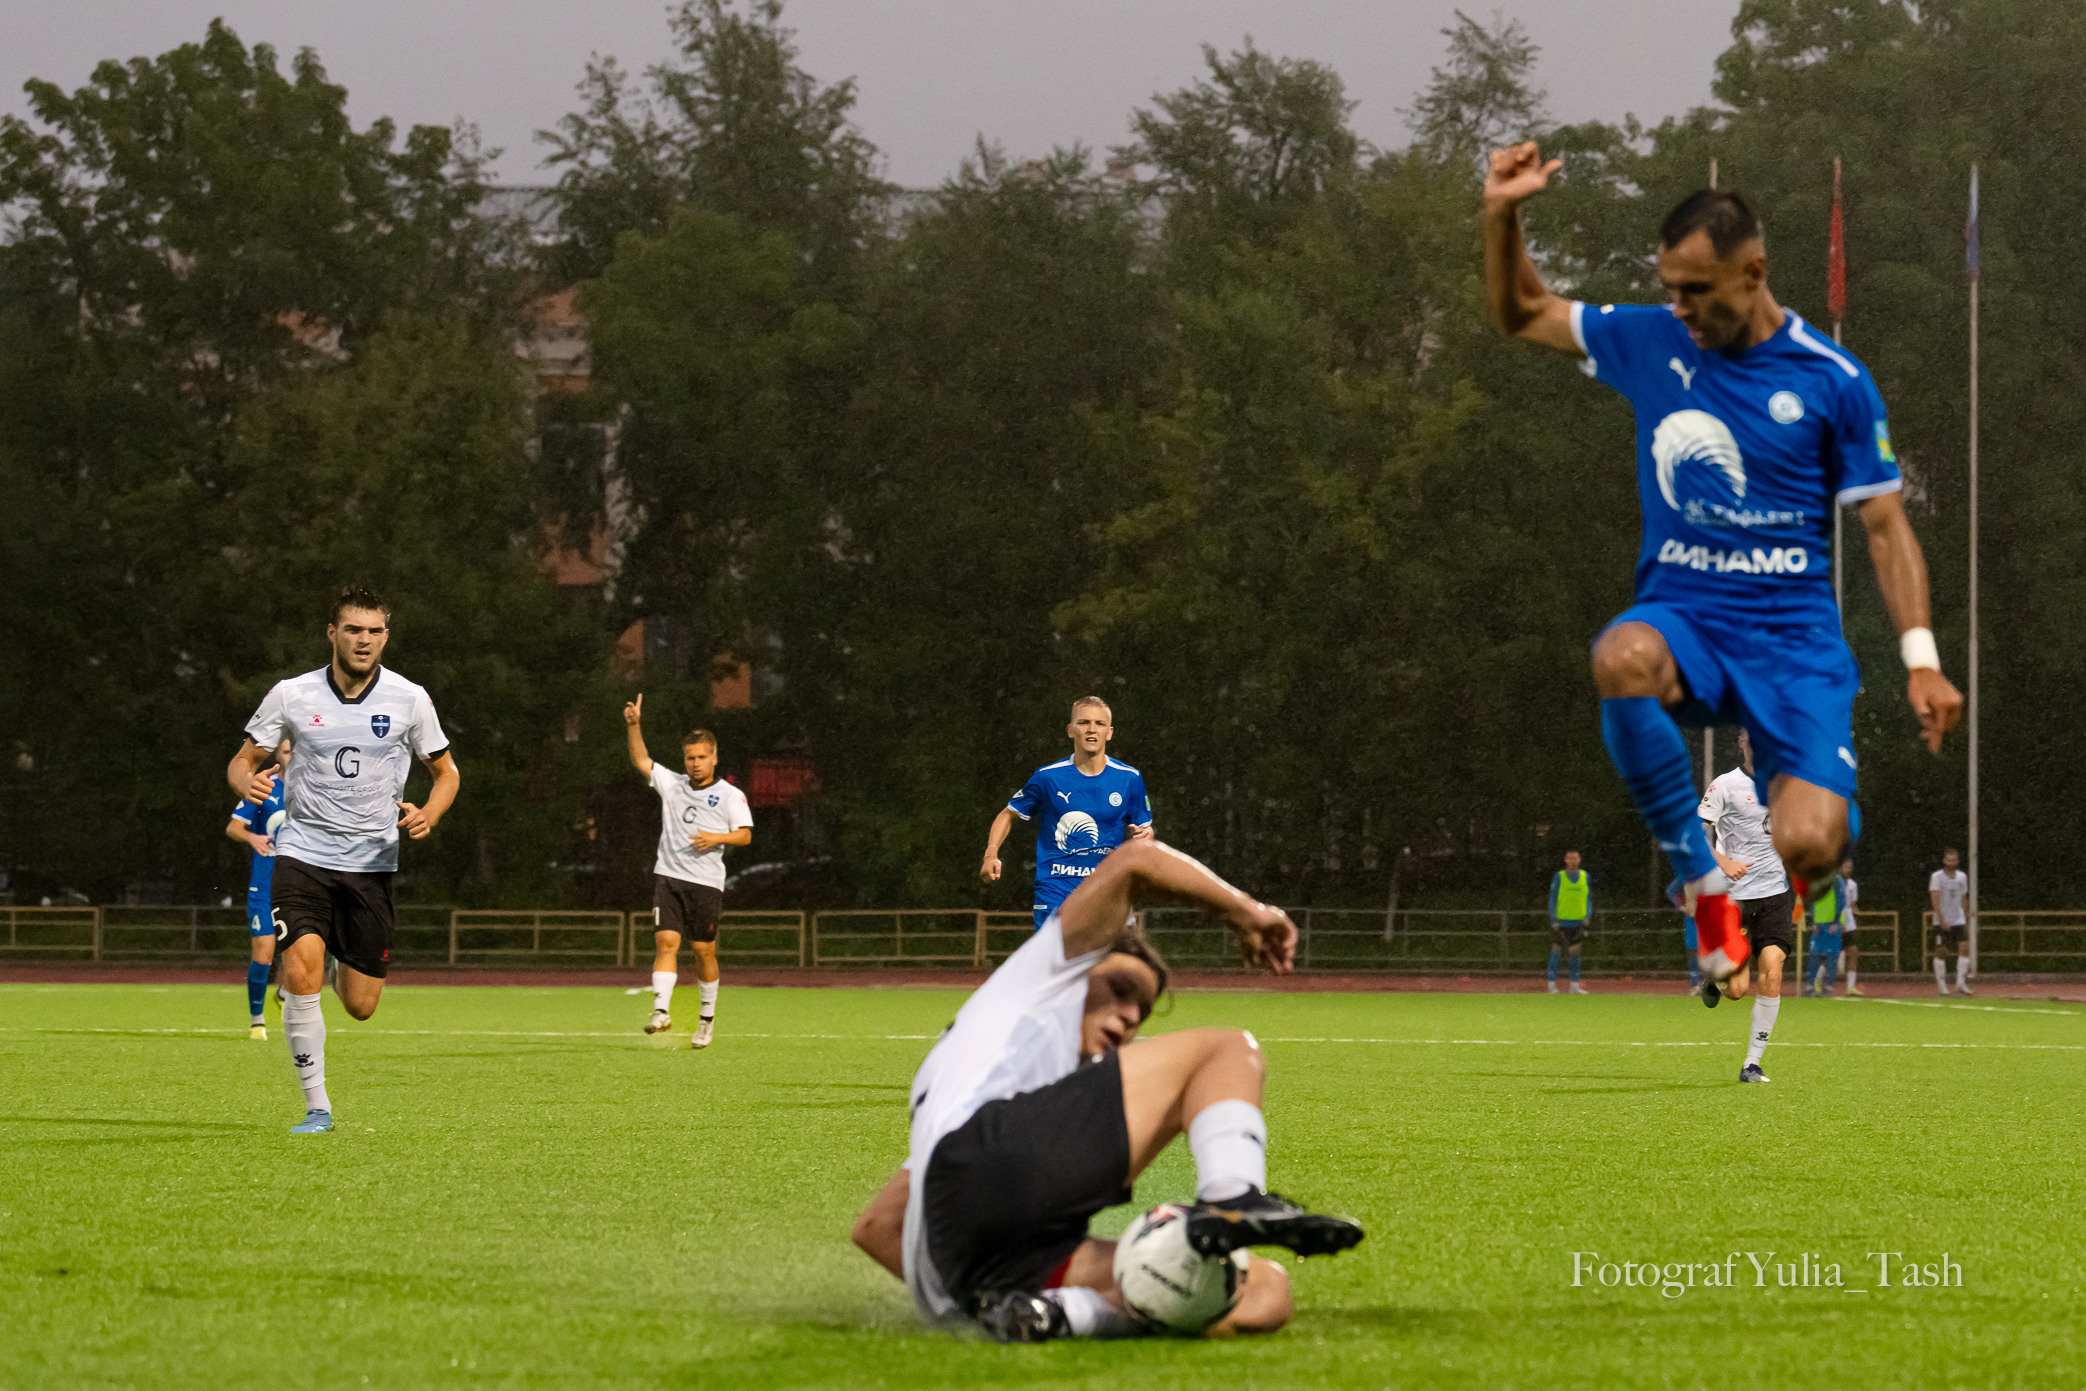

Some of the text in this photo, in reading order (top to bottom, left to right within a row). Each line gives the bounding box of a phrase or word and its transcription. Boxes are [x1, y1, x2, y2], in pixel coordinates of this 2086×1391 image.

[1657, 538, 1808, 574] ДИНАМО
[335, 745, 361, 778] G
[682, 805, 697, 824] G
[1051, 863, 1096, 877] ДИНА
[252, 914, 261, 931] 4
[271, 906, 288, 941] 5
